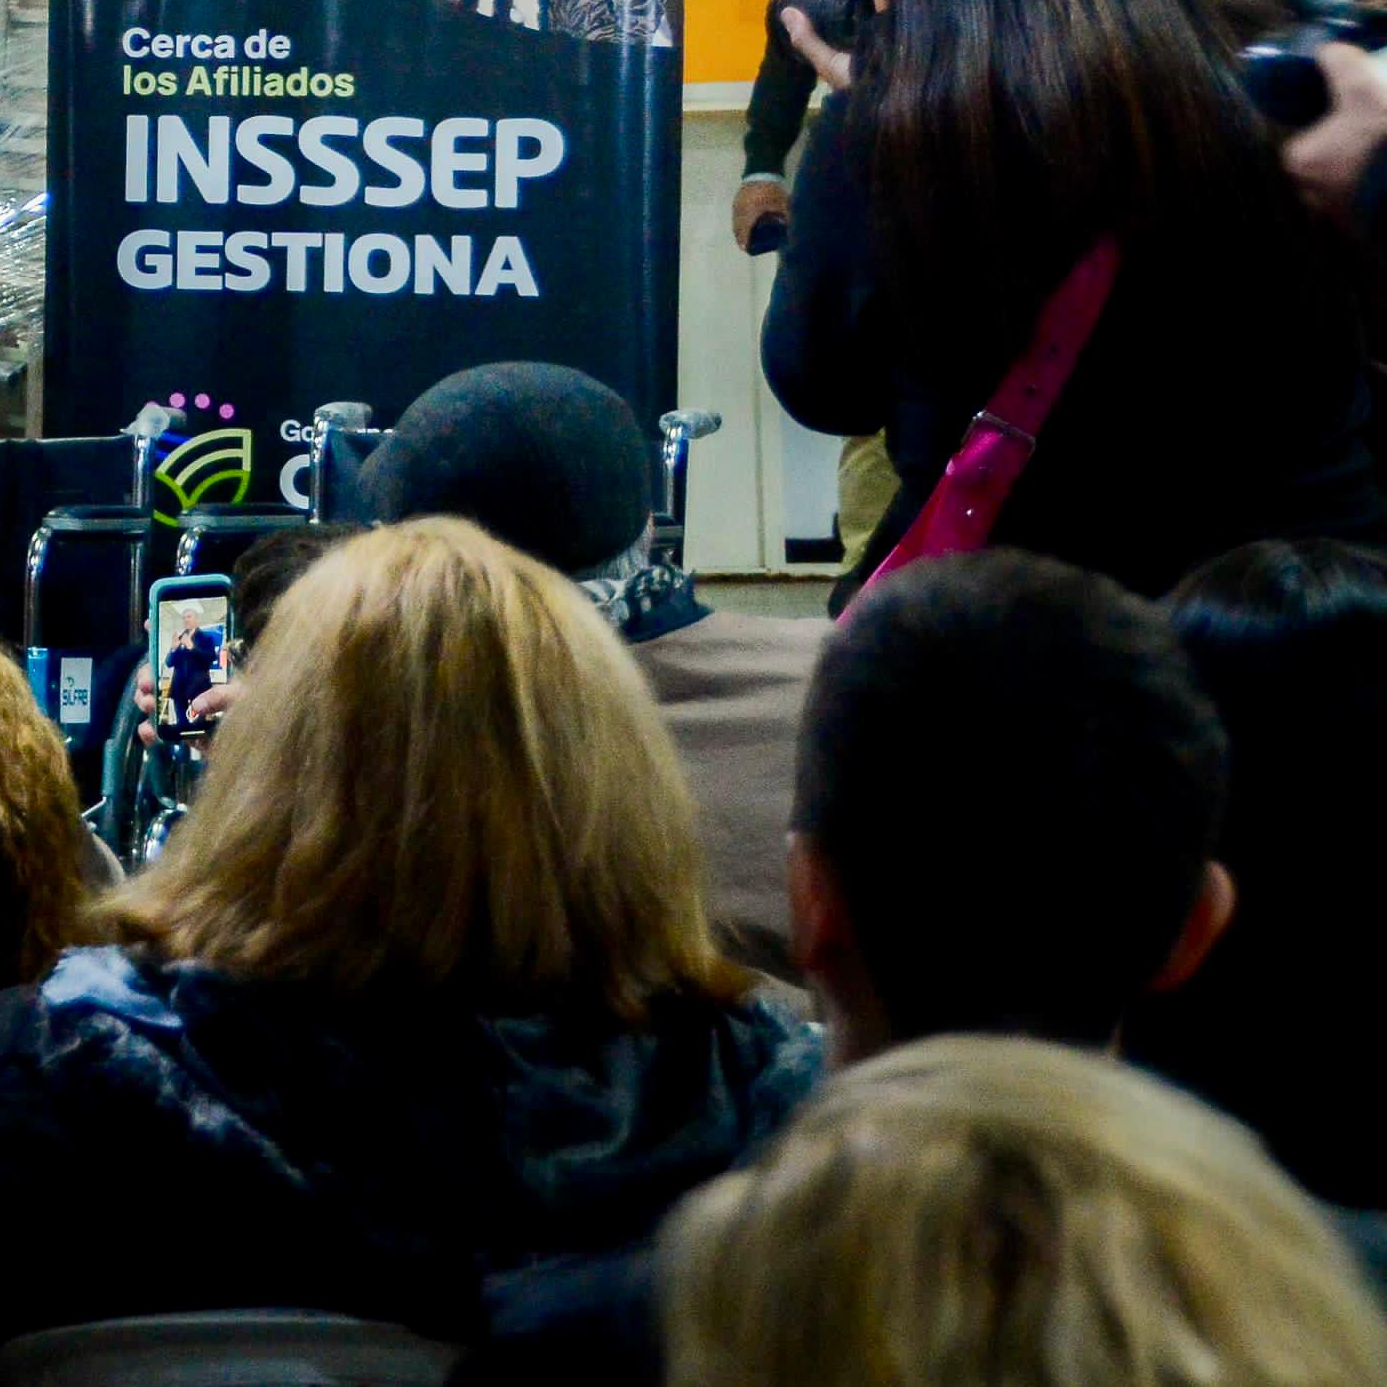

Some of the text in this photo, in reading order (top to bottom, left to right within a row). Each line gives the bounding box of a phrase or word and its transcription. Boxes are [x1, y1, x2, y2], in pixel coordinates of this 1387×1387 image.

[122, 28, 290, 59] Cerca de
[124, 65, 355, 97] los Afiliados
[125, 114, 564, 209] INSSSEP
[117, 228, 539, 297] GESTIONA
